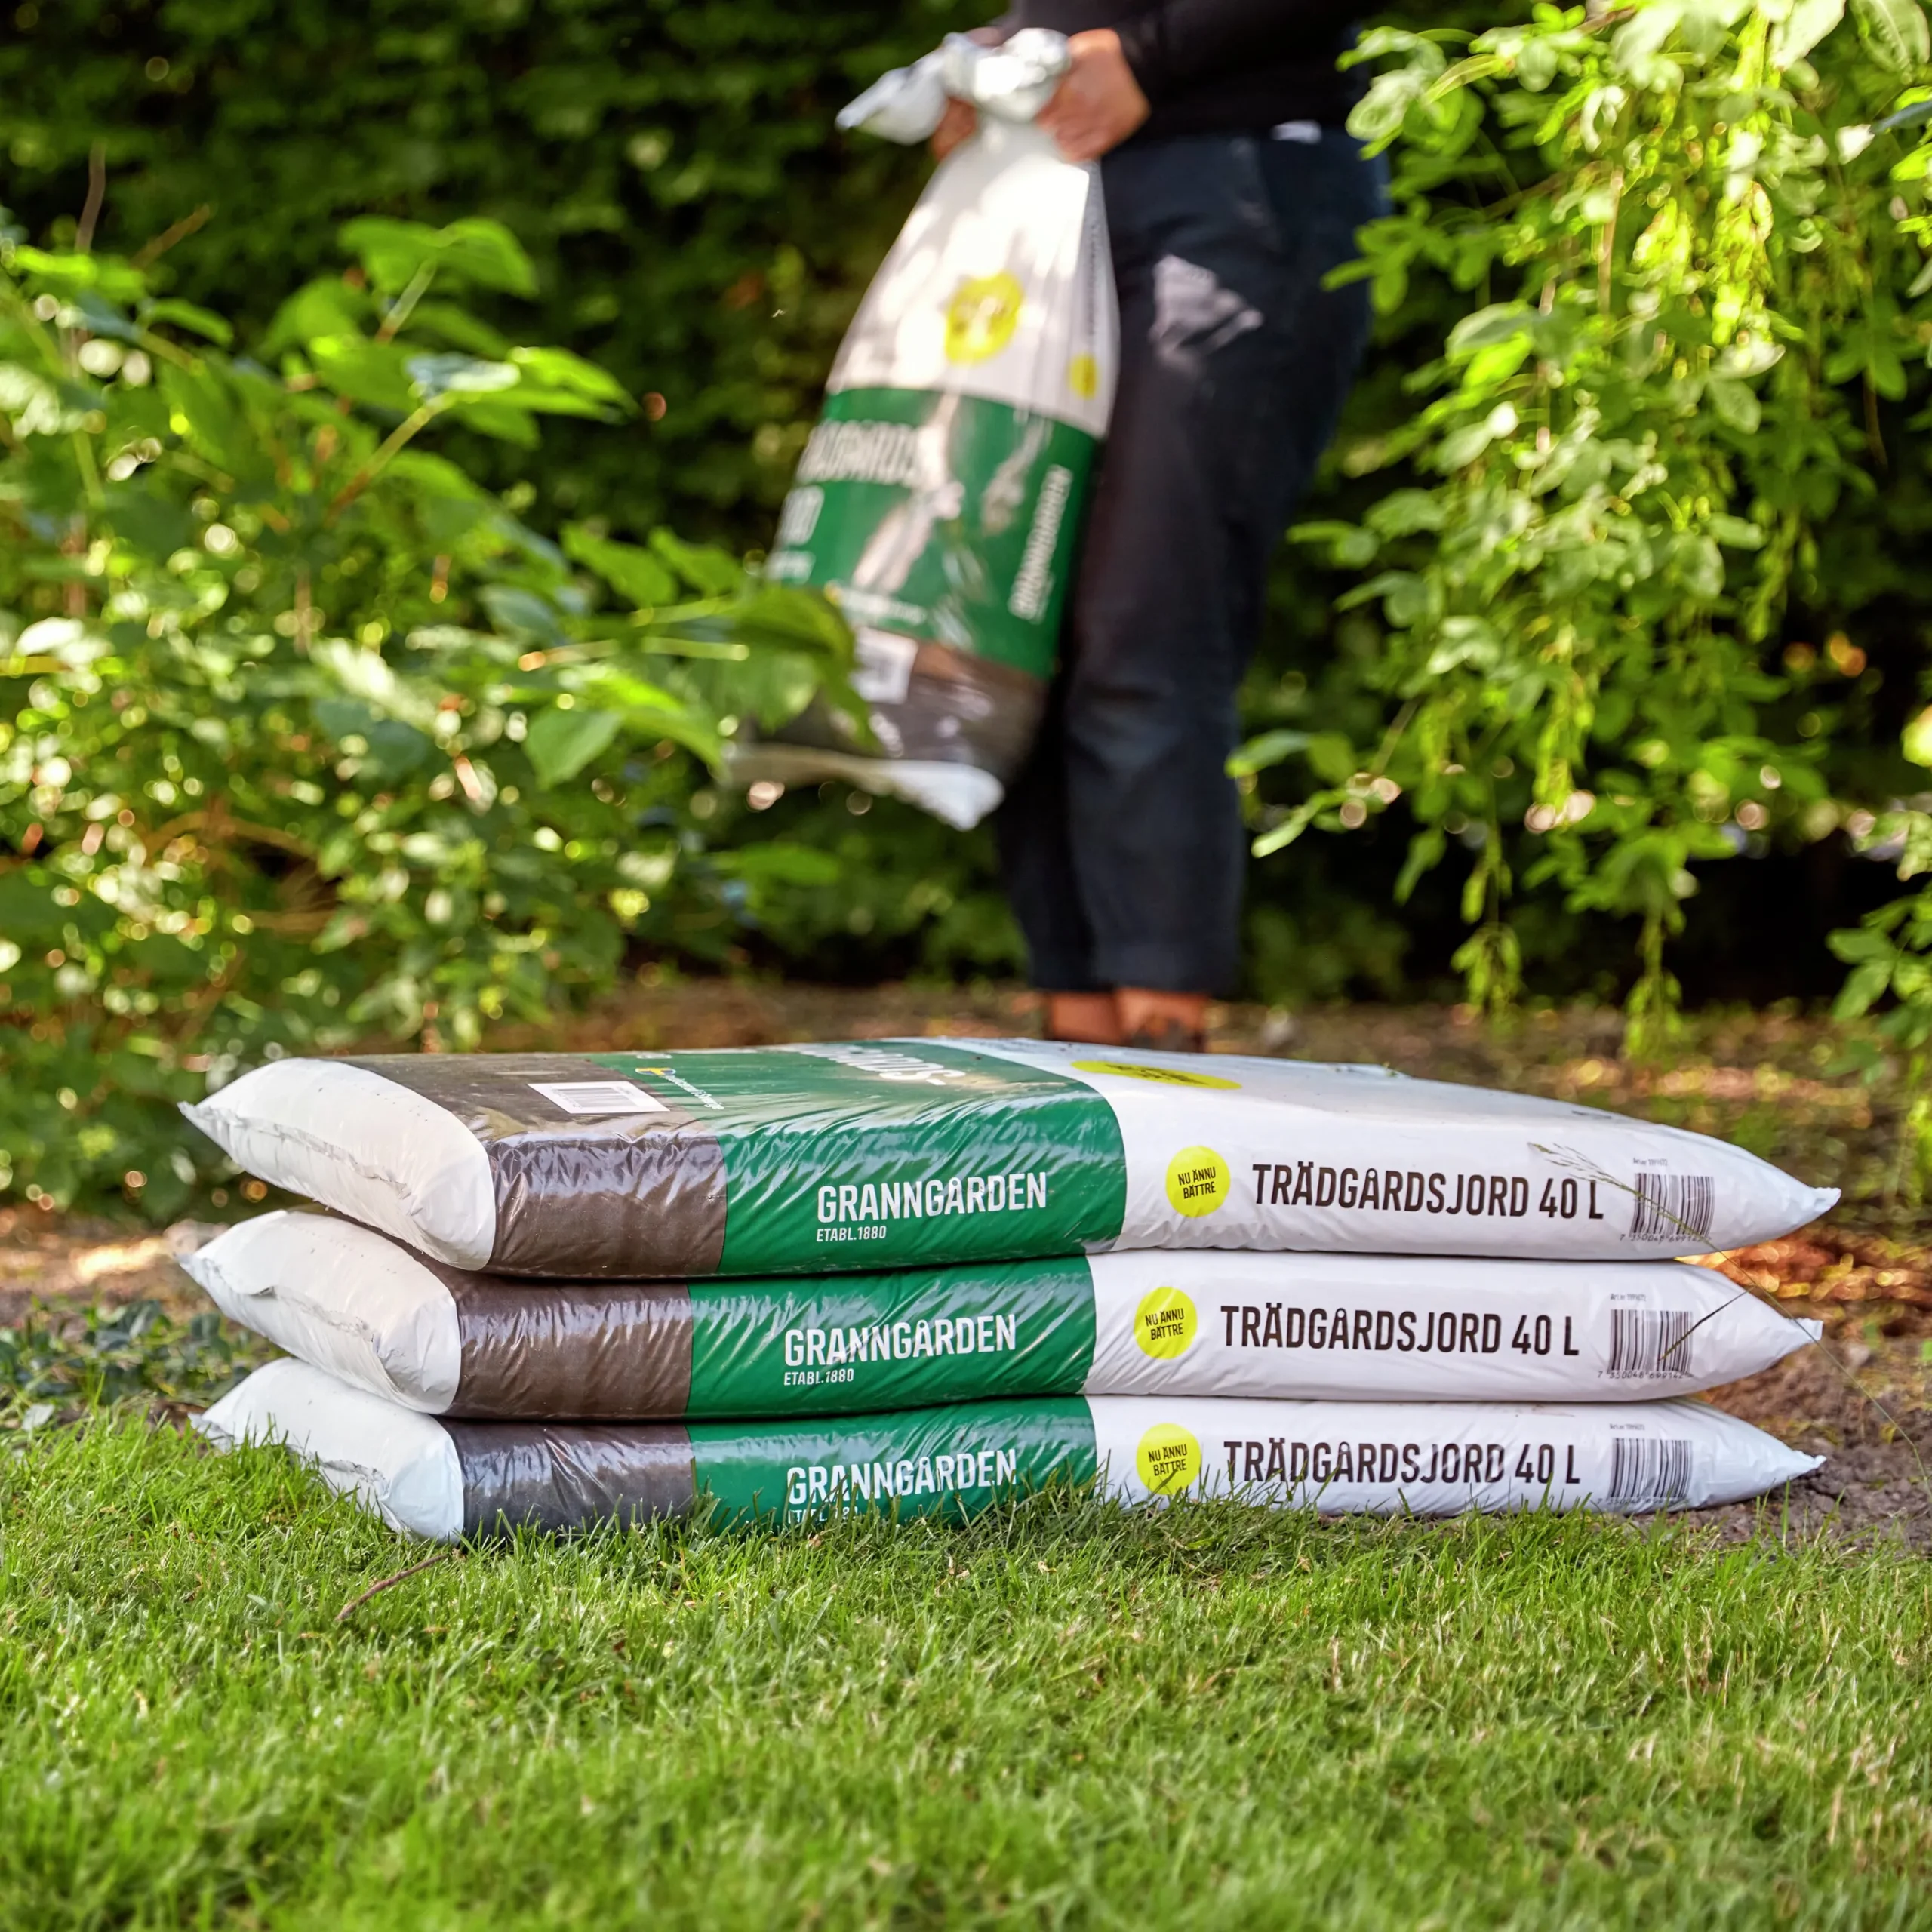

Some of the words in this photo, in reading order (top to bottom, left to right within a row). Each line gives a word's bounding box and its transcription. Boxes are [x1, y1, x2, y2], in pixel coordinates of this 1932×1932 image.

[1177, 1172, 1191, 1186] NU
[1192, 1166, 1216, 1183] ÄNNU
[817, 1171, 1046, 1223] GRANNGÅRDEN
[1183, 1181, 1216, 1199] BÄTTRE
[1252, 1161, 1529, 1217] TRÄDGÅRDSJORD
[1539, 1177, 1577, 1219] 40
[1589, 1180, 1604, 1220] L
[816, 1225, 887, 1241] ETABL.1880
[1145, 1313, 1158, 1327] NU
[1160, 1308, 1184, 1324] ÄNNU
[1150, 1323, 1183, 1340] BÄTTRE
[1220, 1302, 1502, 1354] TRÄDGÅRDSJORD
[1512, 1314, 1552, 1355] 40
[1564, 1315, 1580, 1356] L
[785, 1314, 1016, 1367] GRANNGÅRDEN
[783, 1368, 854, 1386] ETABL.1880
[1148, 1449, 1161, 1463] NU
[1163, 1444, 1187, 1460] ÄNNU
[1223, 1437, 1505, 1484] TRÄDGÅRDSJORD
[1515, 1444, 1555, 1484] 40
[1565, 1445, 1581, 1484] L
[786, 1448, 1017, 1505] GRANNGÅRDEN
[1153, 1459, 1187, 1476] BÄTTRE
